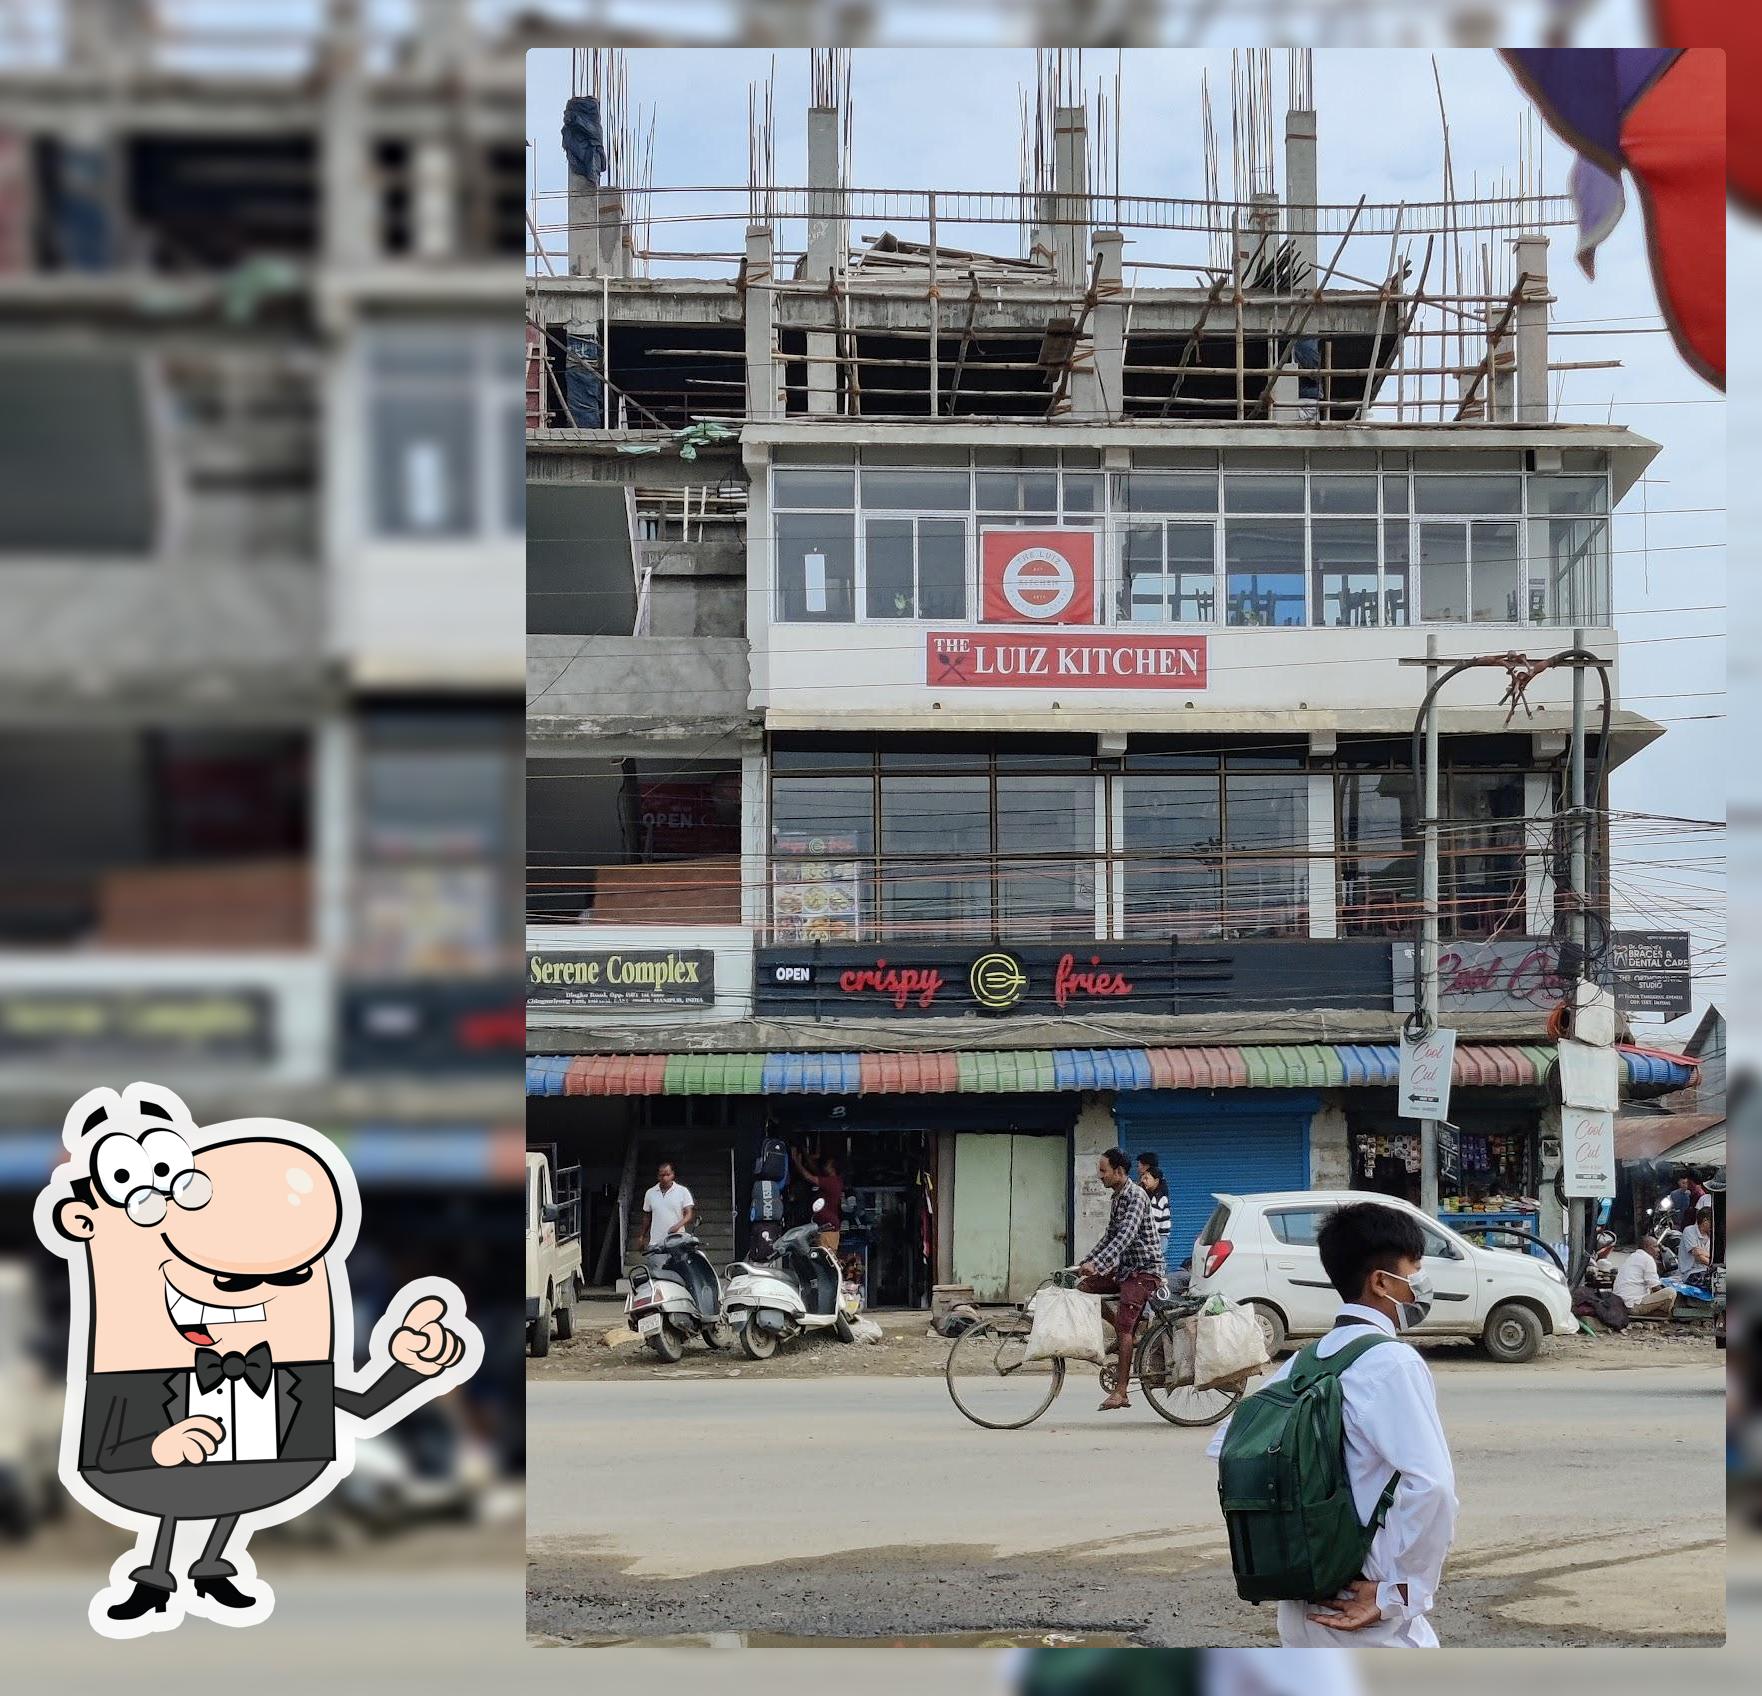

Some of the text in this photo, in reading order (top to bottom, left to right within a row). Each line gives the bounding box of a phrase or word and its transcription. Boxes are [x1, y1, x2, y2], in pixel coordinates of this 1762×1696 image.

[1040, 551, 1061, 565] LUIZ
[934, 639, 969, 653] THE
[974, 647, 1199, 676] LUIZ KITCHEN
[1628, 950, 1673, 958] BRACES &
[1628, 959, 1689, 967] DENTAL CARE
[530, 954, 699, 991] Serene Complex
[776, 967, 810, 981] OPEN
[840, 953, 1134, 1009] crispy fries
[1412, 1041, 1444, 1061] Cool
[1575, 1119, 1605, 1139] Cool
